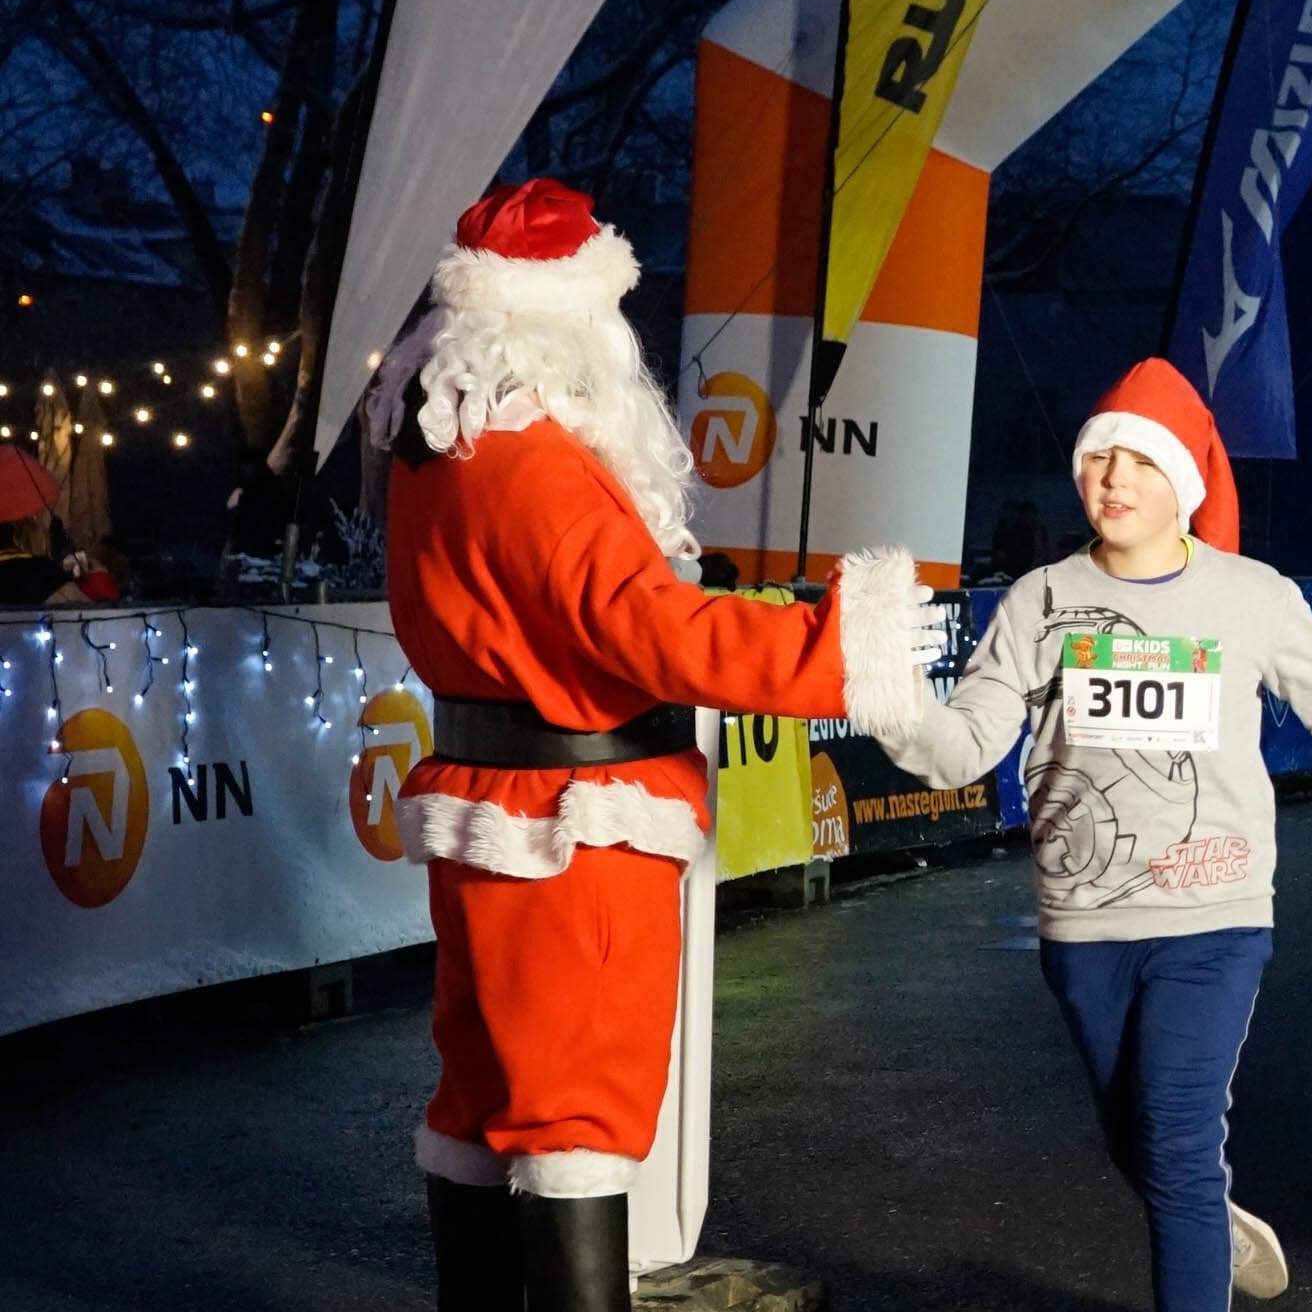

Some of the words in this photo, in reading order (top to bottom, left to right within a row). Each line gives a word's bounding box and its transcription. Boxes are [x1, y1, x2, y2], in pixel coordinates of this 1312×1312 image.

[799, 415, 879, 457] NN
[1134, 639, 1170, 654] KIDS
[1088, 677, 1185, 720] 3101
[168, 760, 254, 824] NN
[1149, 836, 1250, 868] STAR
[1150, 858, 1248, 889] WARS
